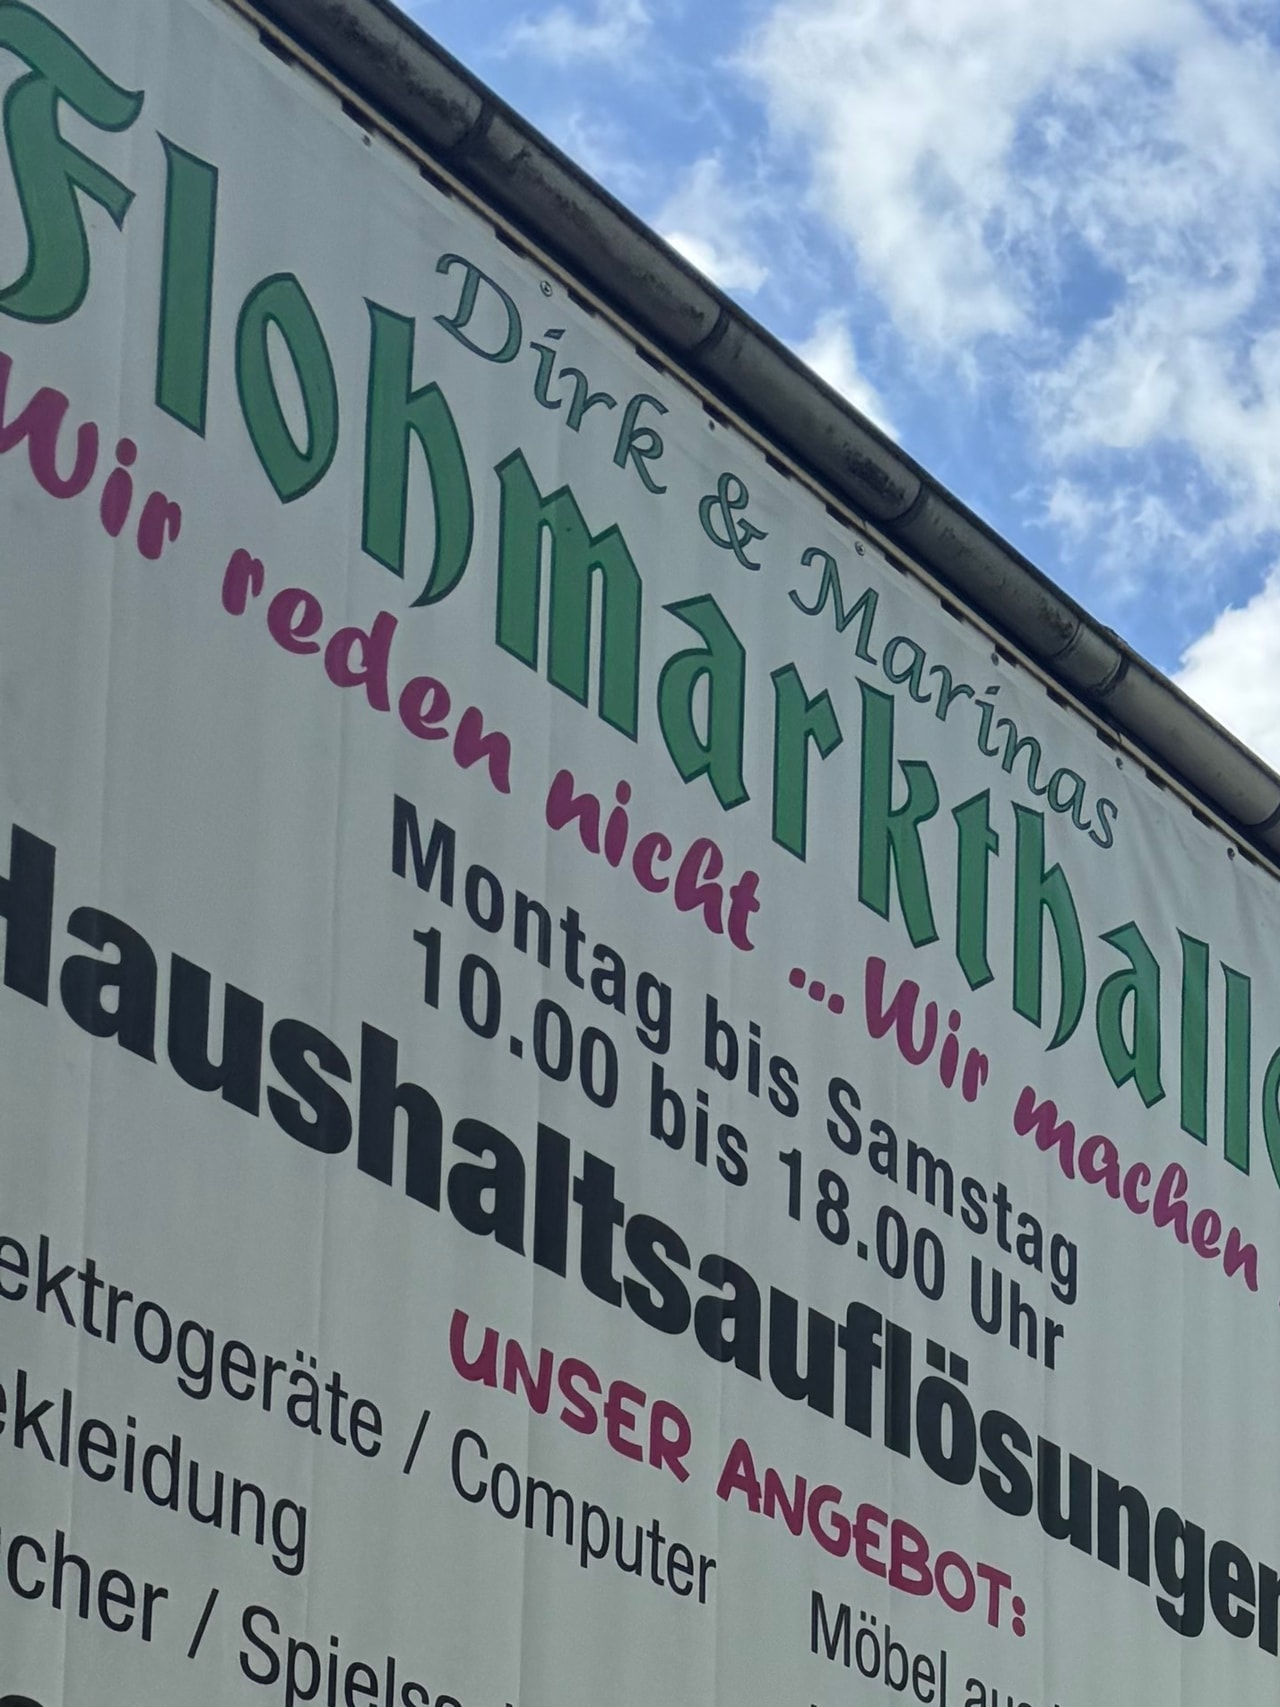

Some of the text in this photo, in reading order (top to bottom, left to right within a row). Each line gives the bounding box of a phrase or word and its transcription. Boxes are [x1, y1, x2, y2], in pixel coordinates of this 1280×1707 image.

[433, 253, 1119, 849] Dirk & Marinas
[0, 352, 181, 560] Wir
[222, 548, 511, 794] reden
[546, 769, 760, 951] nicht
[1014, 1086, 1258, 1291] machen
[392, 793, 1077, 1305] Montag bis Samstag
[413, 927, 1064, 1370] 10.00 bis 18.00 Uhr
[0, 1369, 306, 1576] kleidung
[187, 1588, 219, 1659] /
[403, 1410, 430, 1474] /
[451, 1428, 716, 1604] Computer
[450, 1309, 1025, 1637] UNSER ANGEBOT:
